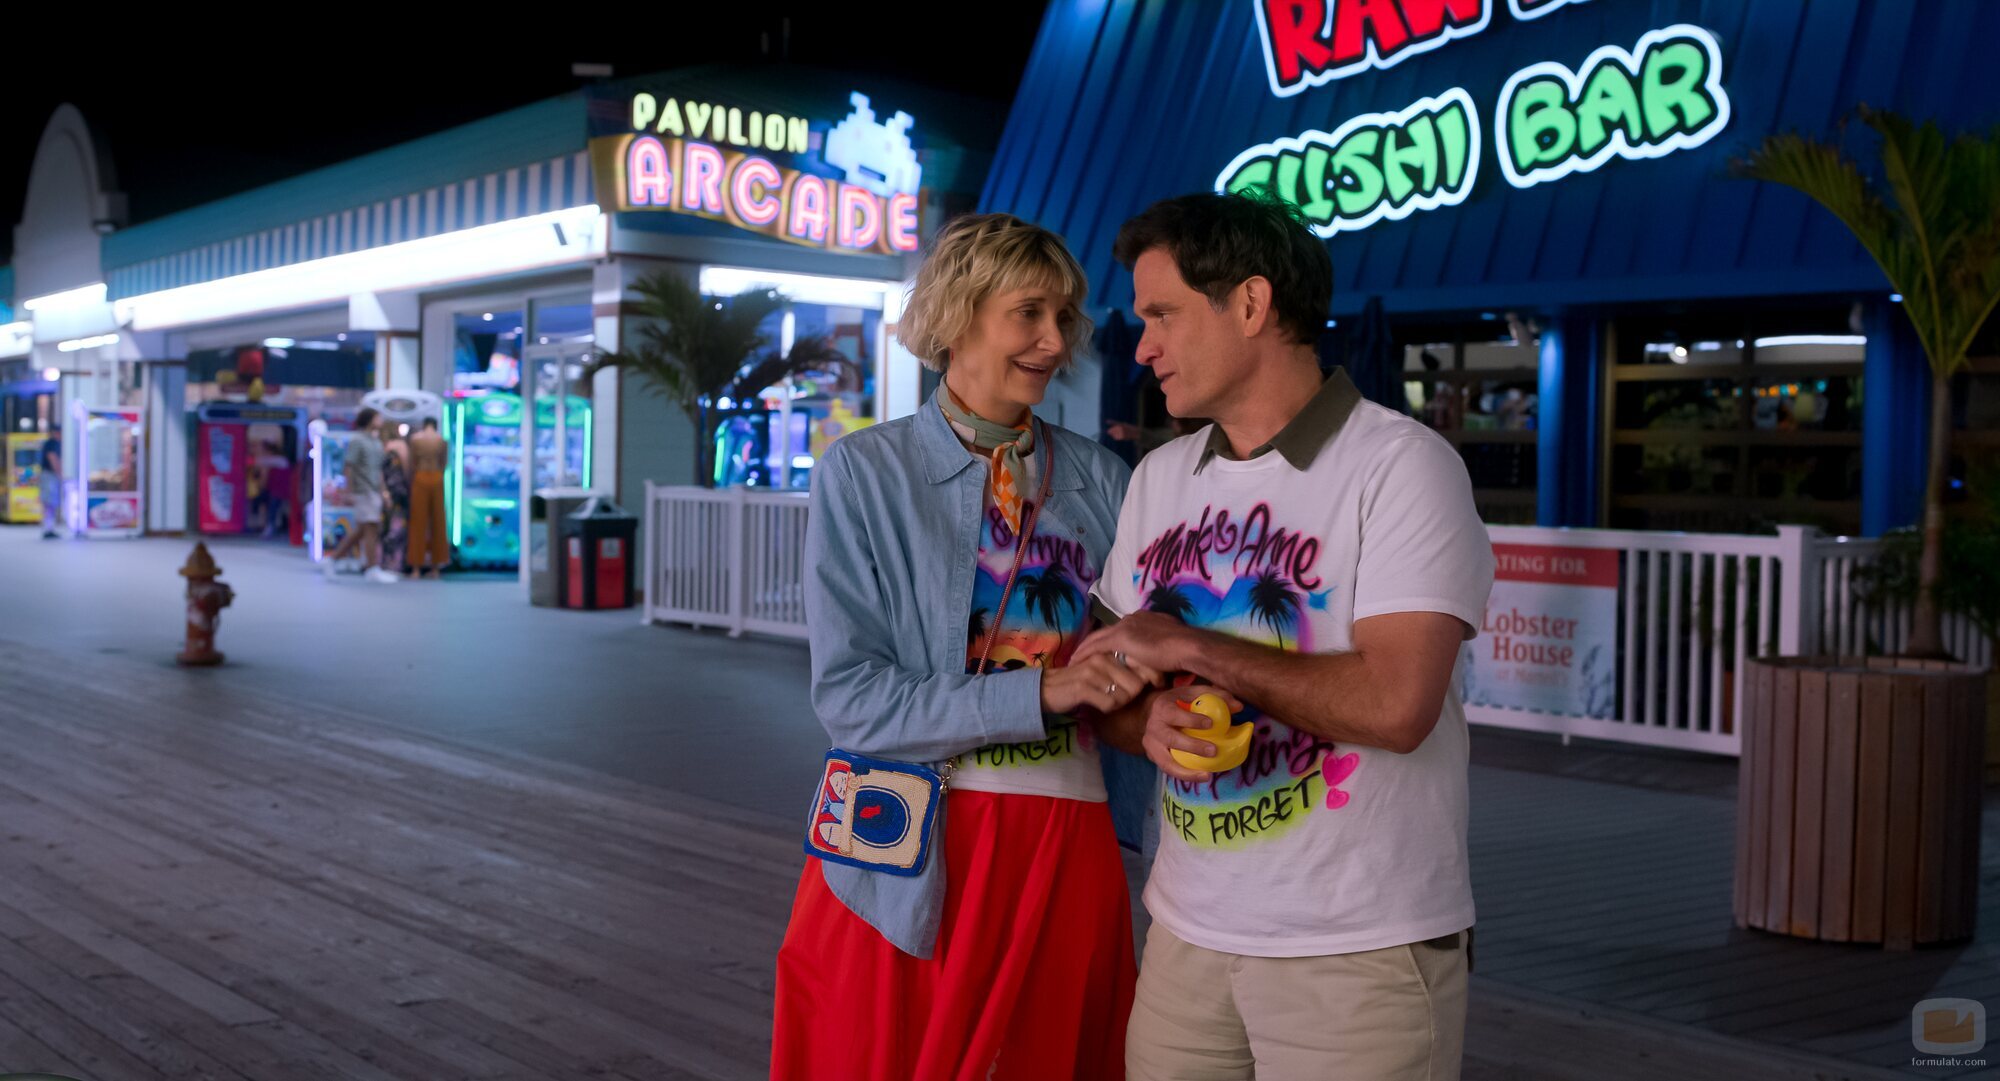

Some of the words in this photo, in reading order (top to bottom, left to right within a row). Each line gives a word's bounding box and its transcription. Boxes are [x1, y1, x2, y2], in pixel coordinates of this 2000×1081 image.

[632, 92, 809, 154] PAVILION
[1508, 41, 1713, 171] BAR
[627, 135, 919, 251] ARCADE
[1137, 504, 1213, 591] Mark
[1234, 502, 1321, 590] Anne
[1550, 556, 1587, 576] FOR
[1481, 608, 1578, 640] Lobster
[1492, 636, 1574, 668] House
[1204, 765, 1321, 844] FORGET
